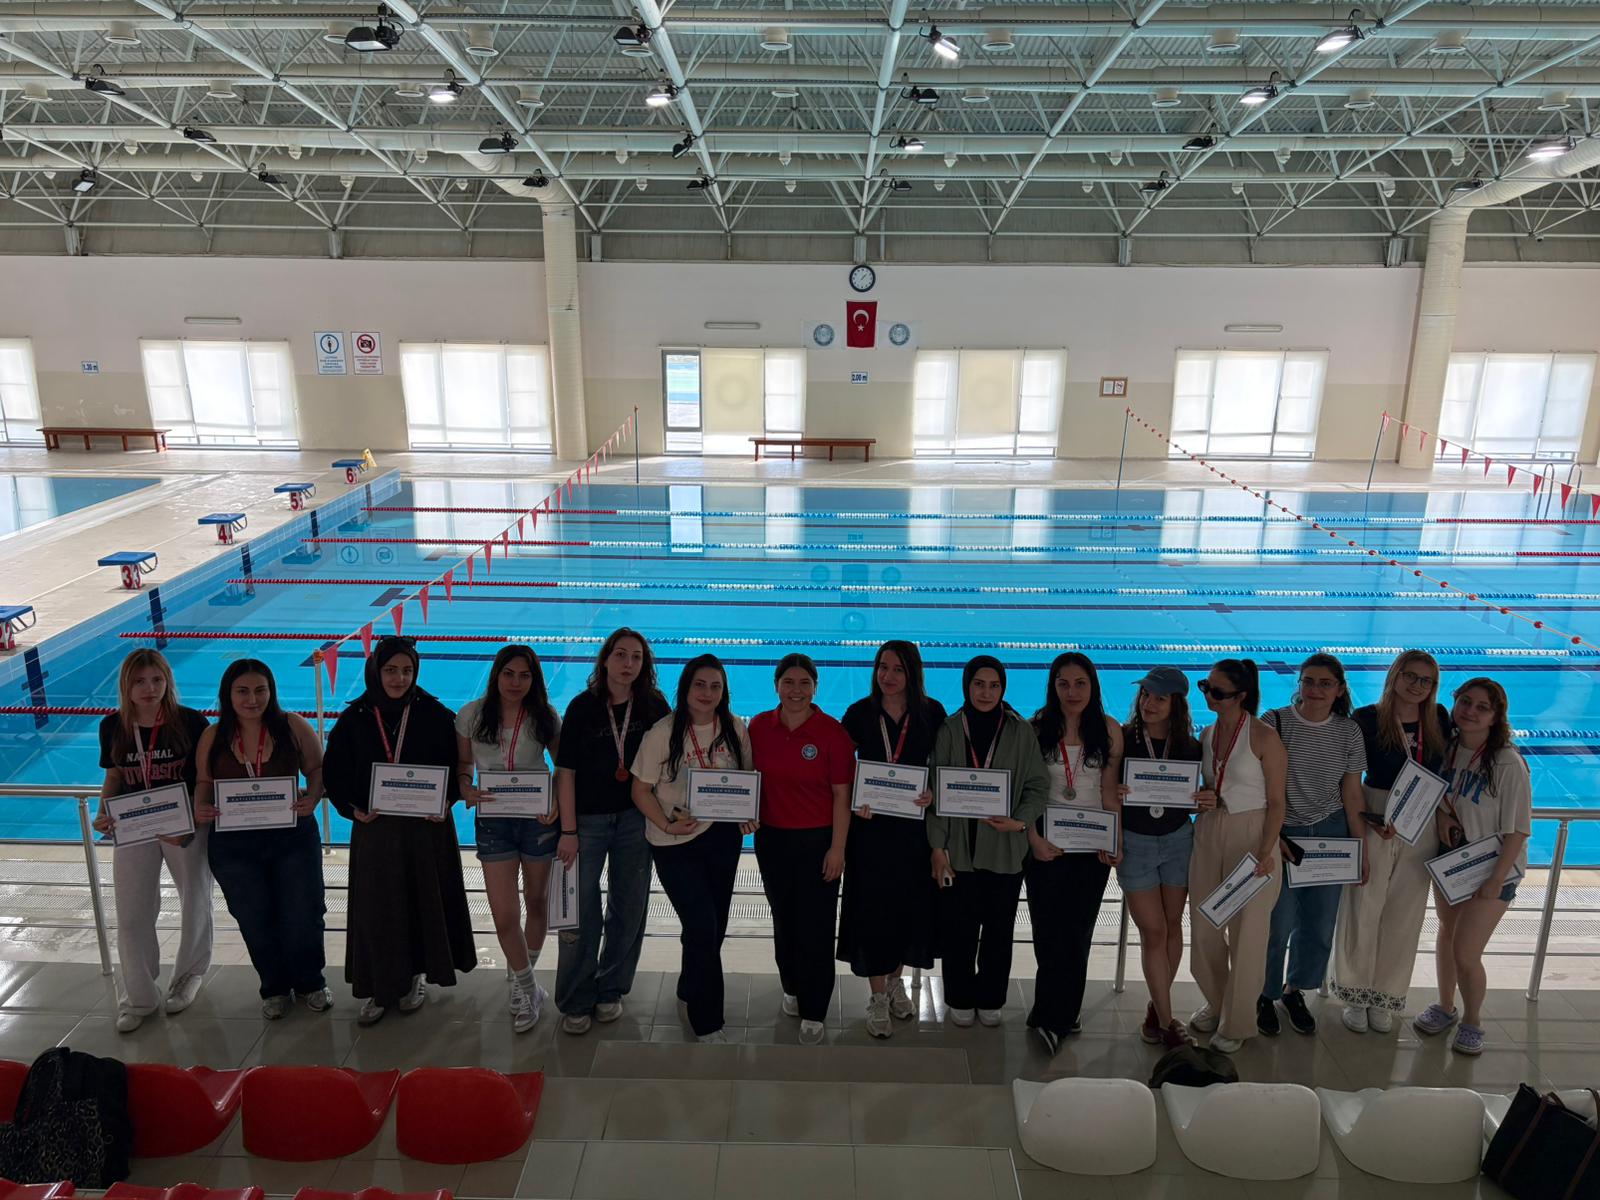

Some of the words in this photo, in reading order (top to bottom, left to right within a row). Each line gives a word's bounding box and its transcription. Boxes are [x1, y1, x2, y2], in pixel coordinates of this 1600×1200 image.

[346, 467, 353, 483] 6
[290, 492, 298, 510] 5
[218, 525, 228, 544] 4
[122, 565, 133, 589] 3
[126, 748, 175, 763] NANAL
